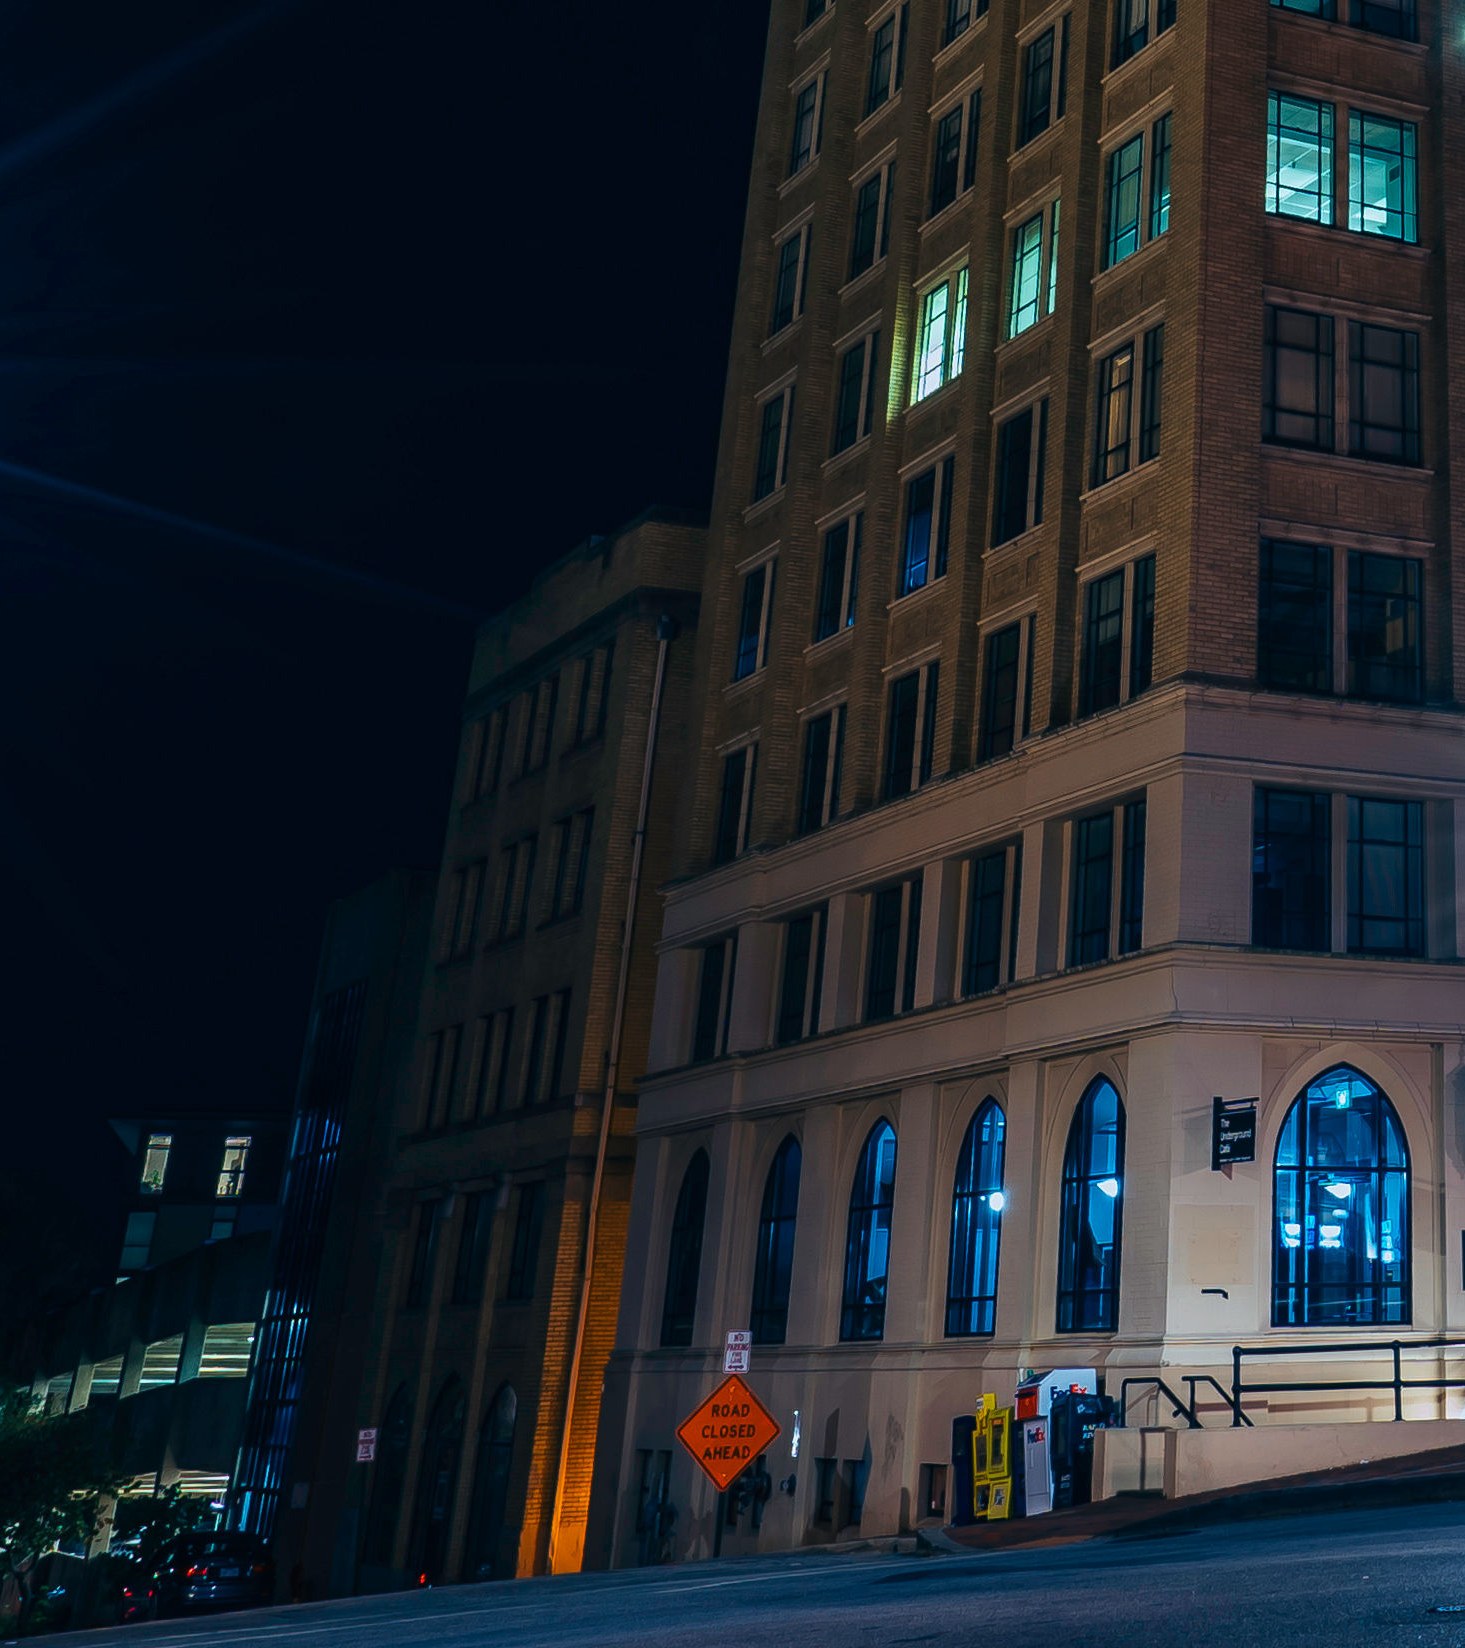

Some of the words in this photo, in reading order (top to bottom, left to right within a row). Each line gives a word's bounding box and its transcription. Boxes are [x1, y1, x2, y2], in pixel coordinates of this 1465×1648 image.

[733, 1333, 745, 1342] NO
[726, 1343, 750, 1351] PARKING
[711, 1404, 750, 1418] ROAD
[701, 1424, 756, 1439] CLOSED
[702, 1445, 751, 1460] AHEAD
